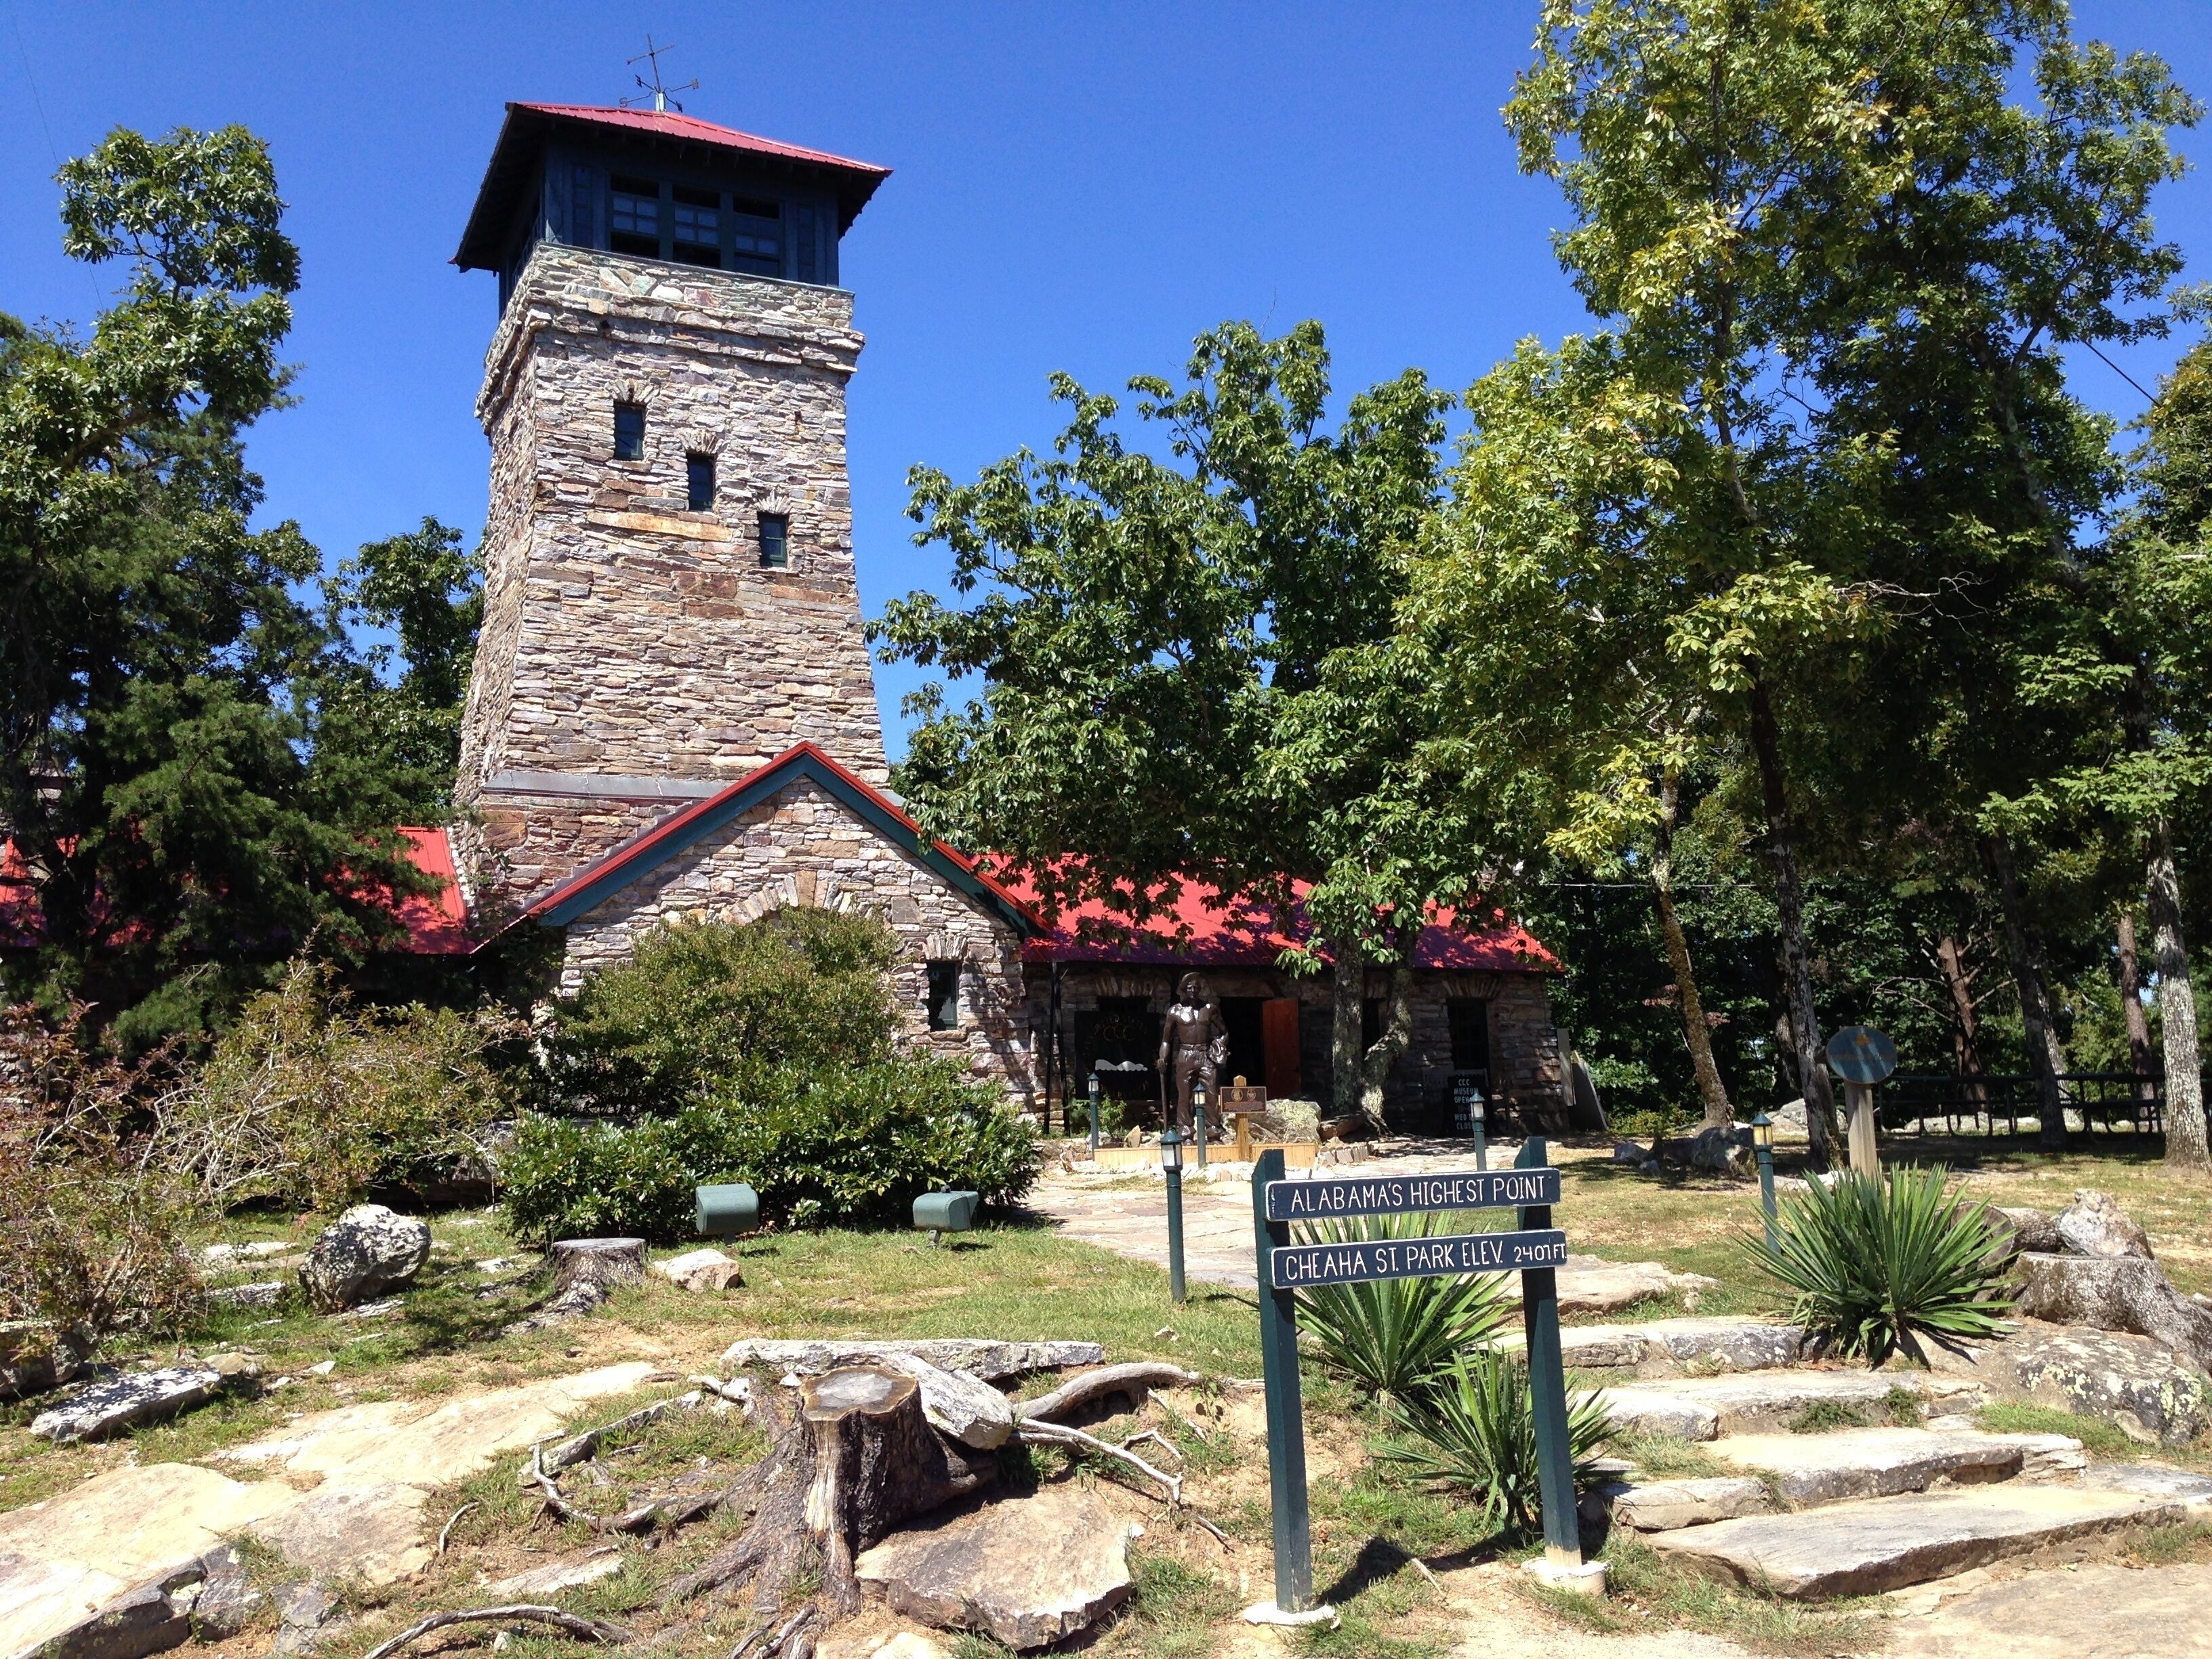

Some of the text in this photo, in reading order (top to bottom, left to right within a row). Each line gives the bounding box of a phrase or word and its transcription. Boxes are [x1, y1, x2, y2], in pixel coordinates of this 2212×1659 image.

[1454, 1087, 1479, 1095] MUSEUM
[1458, 1078, 1470, 1086] CCC
[1291, 1175, 1544, 1212] ALABAMA'S HIGHEST POINT
[1286, 1250, 1368, 1280] CHEAHA
[1375, 1247, 1399, 1273] ST.
[1406, 1243, 1455, 1270] PARK
[1461, 1240, 1504, 1267] ELEV.
